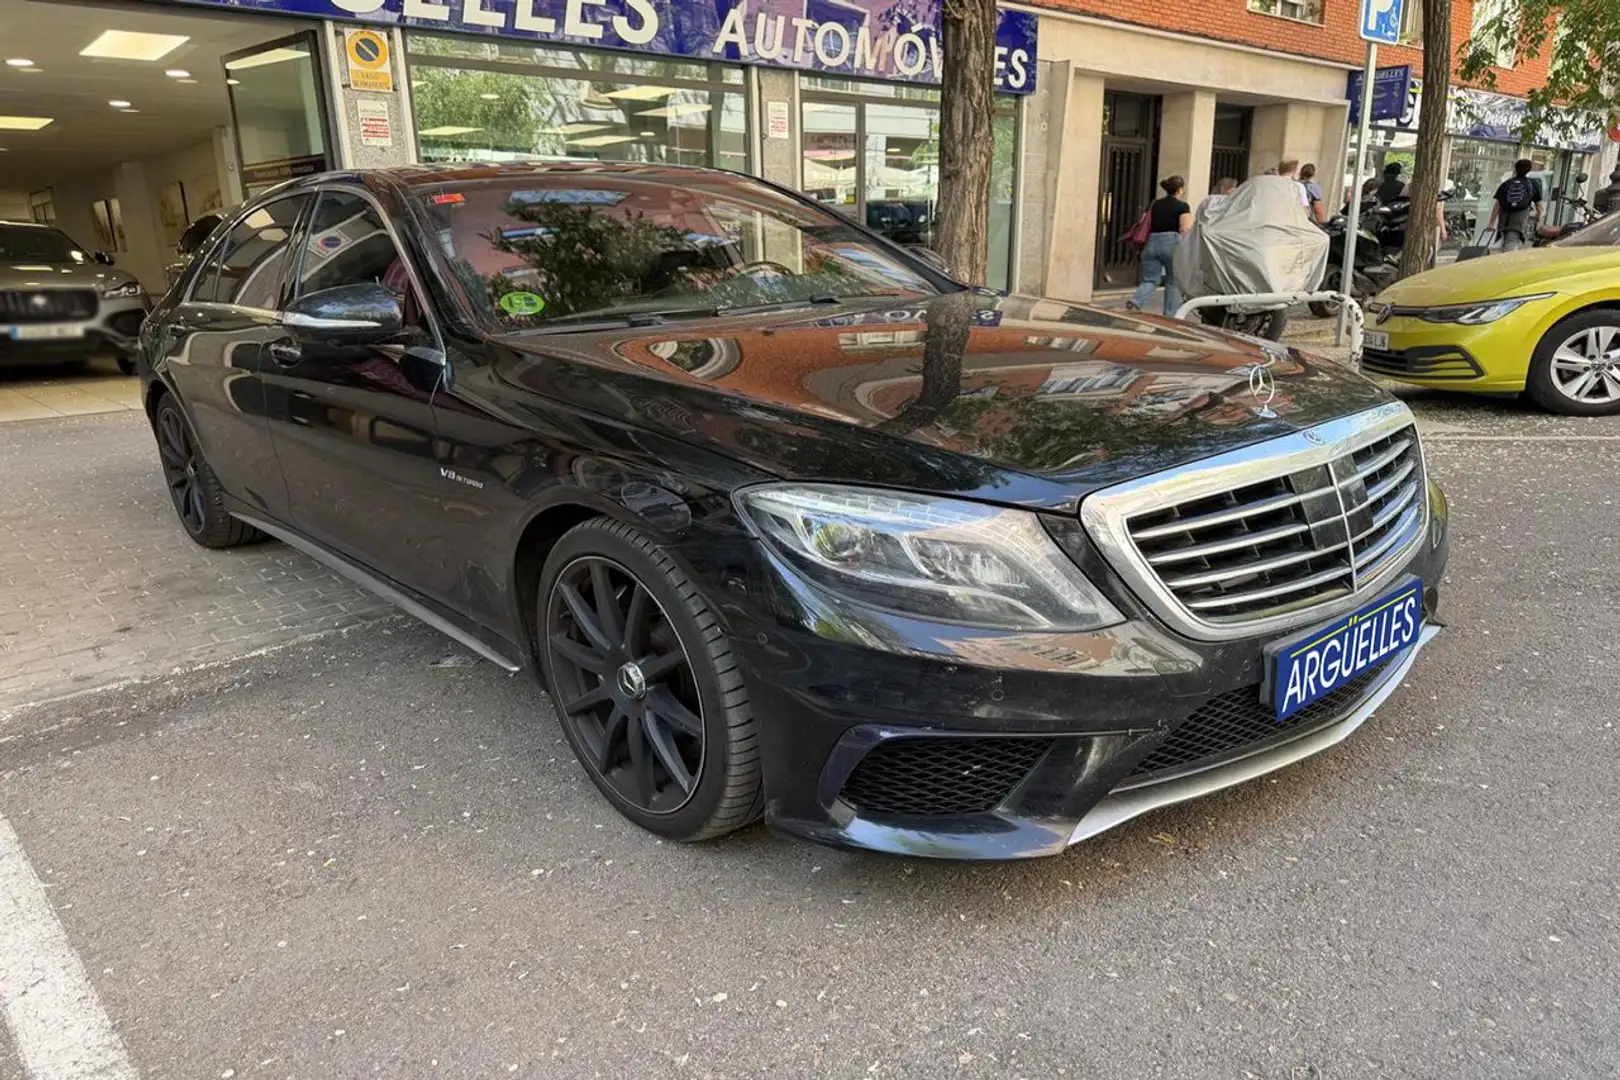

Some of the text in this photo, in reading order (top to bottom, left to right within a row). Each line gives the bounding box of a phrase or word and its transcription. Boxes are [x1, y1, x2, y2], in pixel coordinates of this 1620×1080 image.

[712, 8, 1028, 88] AUTOMÓVES
[440, 467, 456, 480] V8
[1281, 597, 1416, 713] ARGÜELLES
